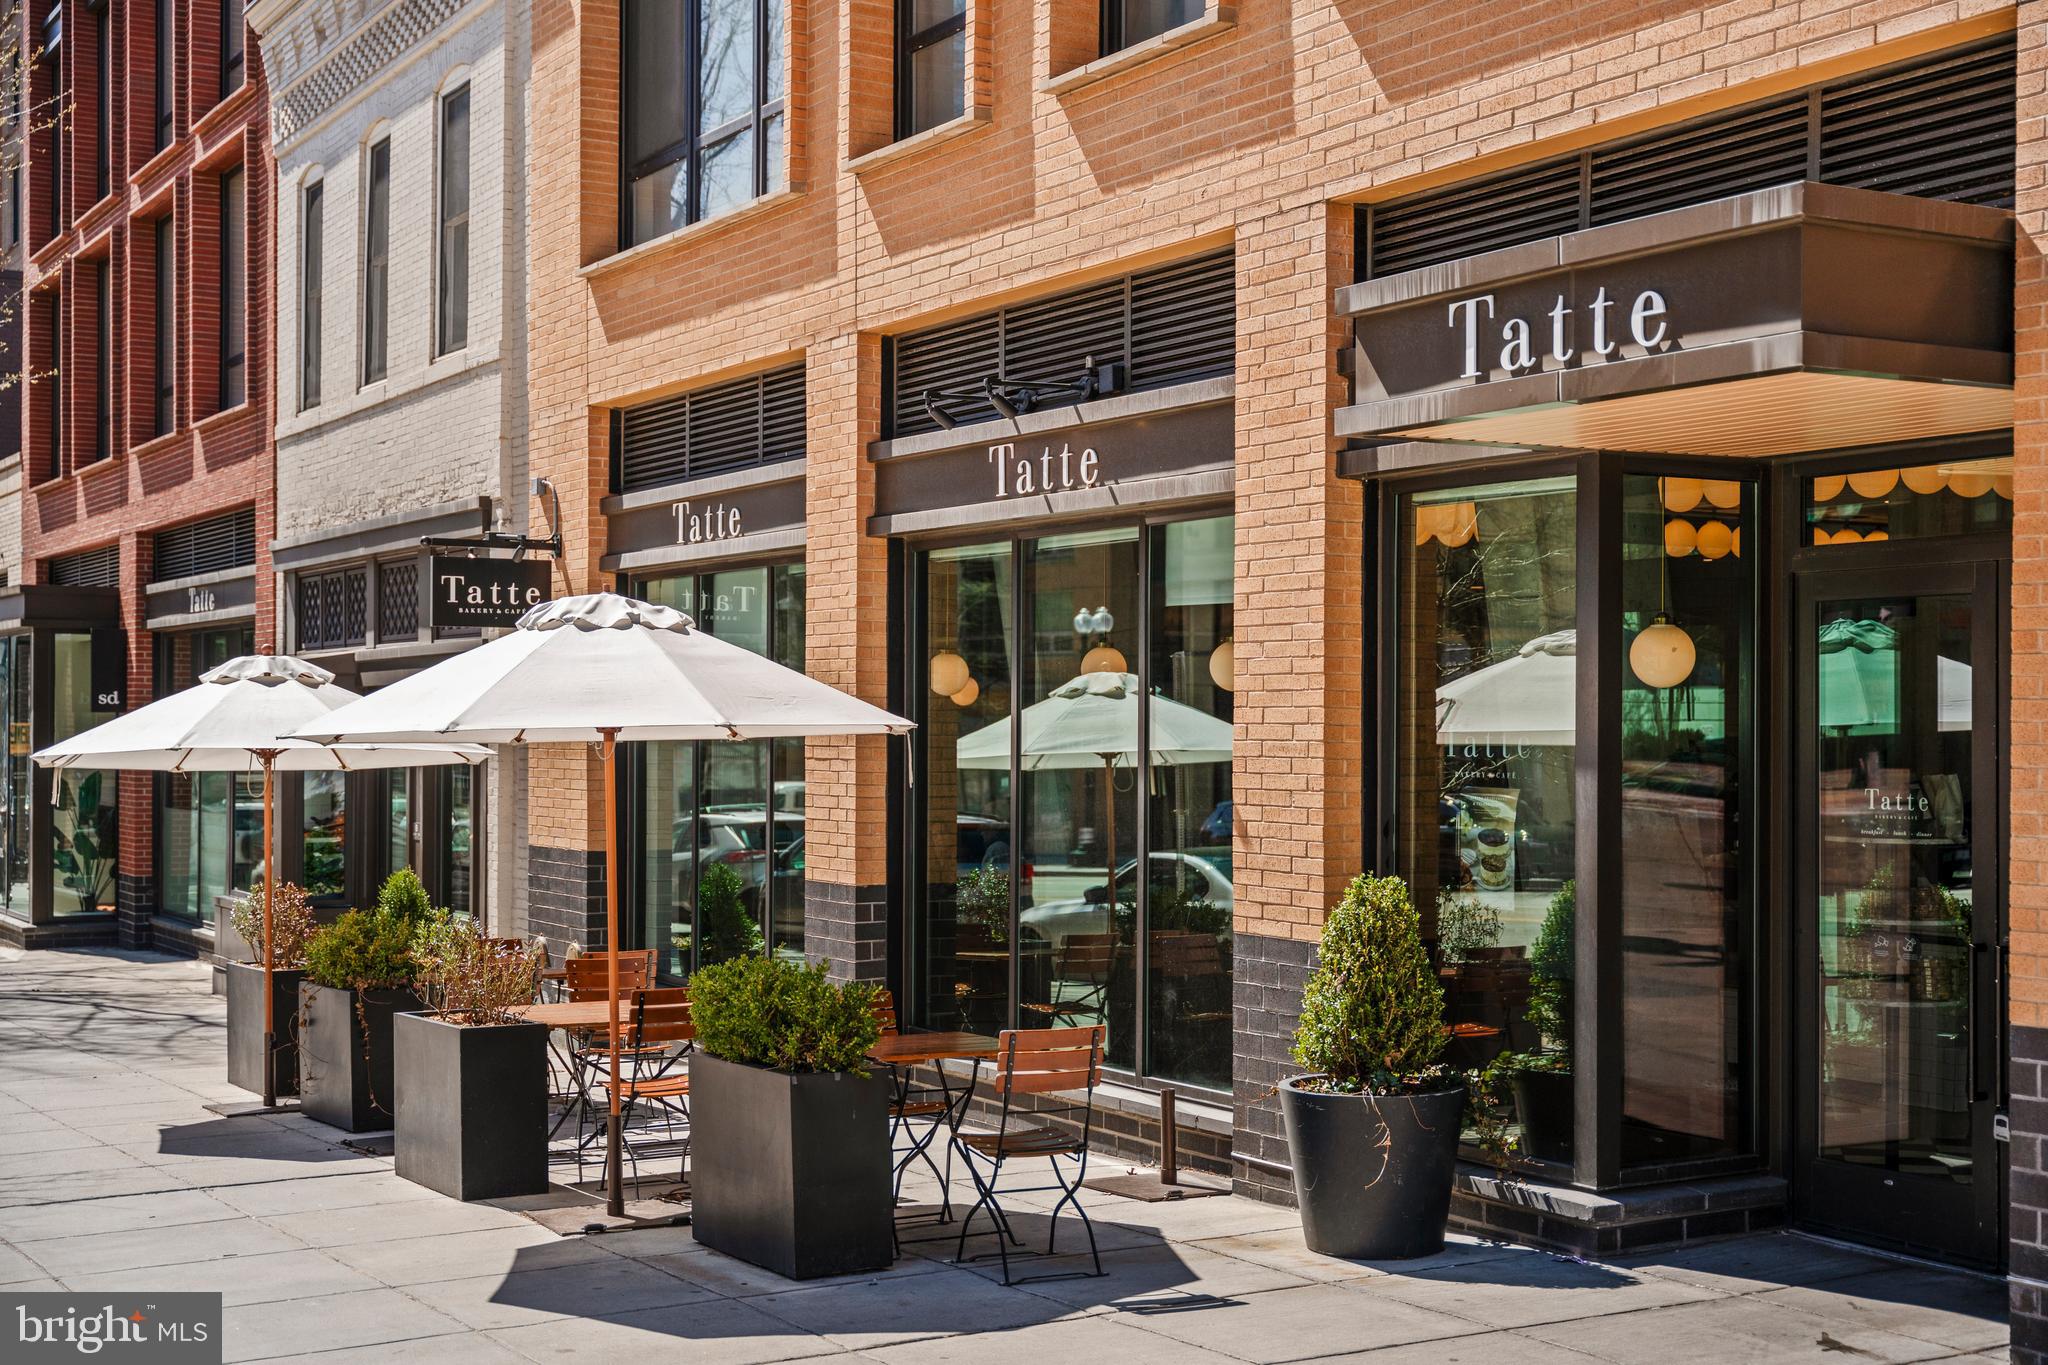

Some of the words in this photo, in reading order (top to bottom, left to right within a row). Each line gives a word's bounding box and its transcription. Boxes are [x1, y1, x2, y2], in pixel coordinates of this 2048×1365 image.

[1448, 286, 1668, 379] Tatte
[988, 442, 1099, 497] Tatte
[672, 501, 741, 544] Tatte
[188, 587, 216, 613] Tatte
[441, 575, 541, 605] Tatte
[98, 690, 120, 705] sd
[1864, 788, 1929, 812] Tatte
